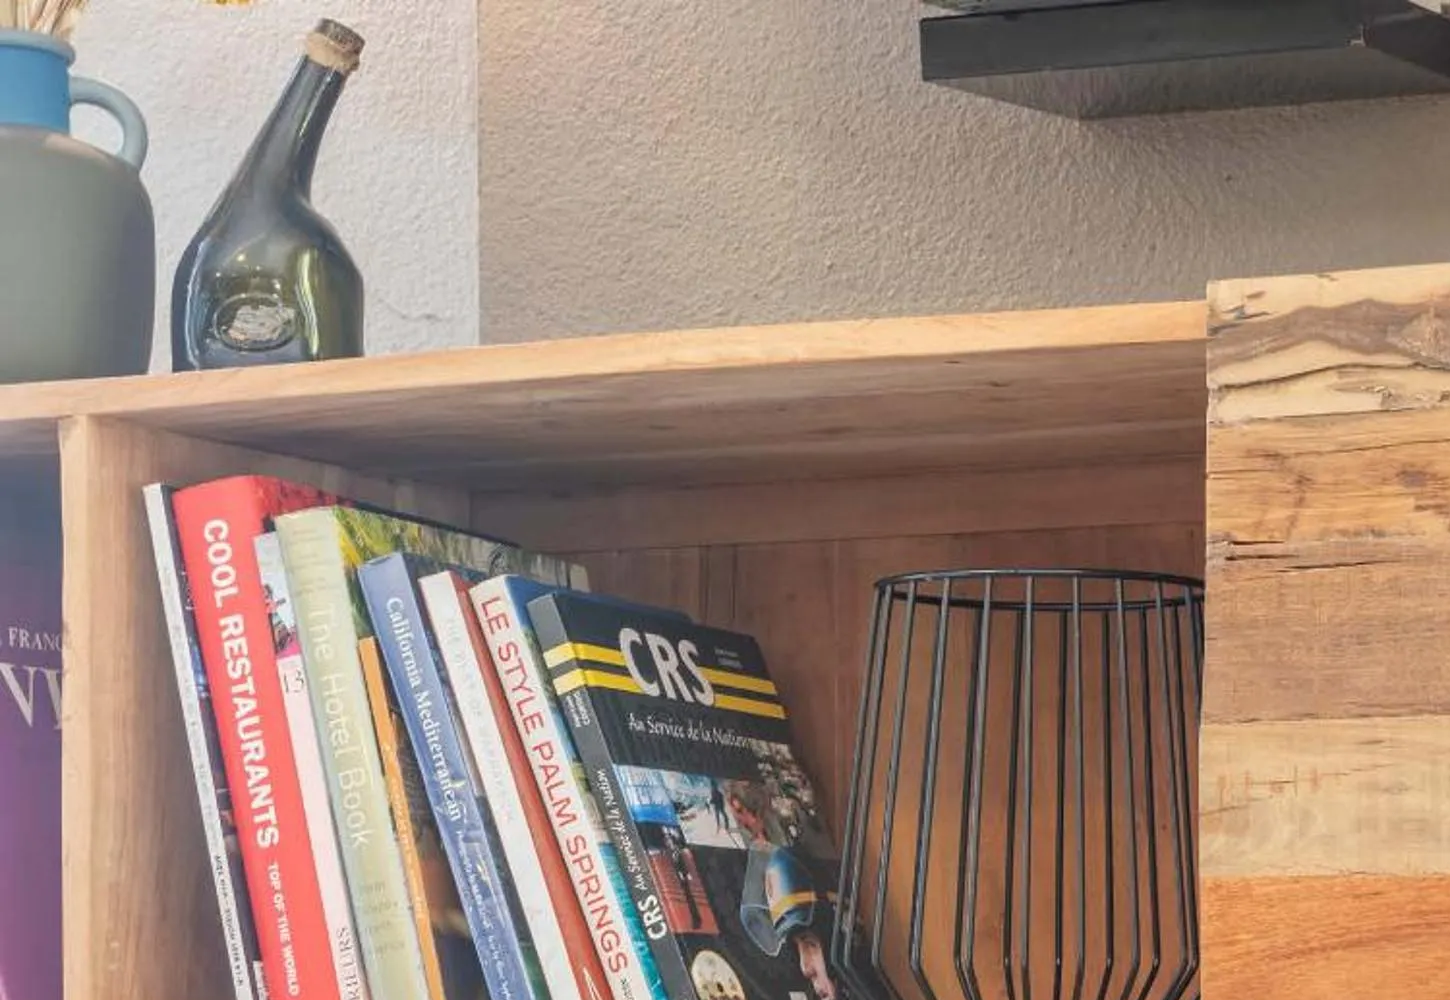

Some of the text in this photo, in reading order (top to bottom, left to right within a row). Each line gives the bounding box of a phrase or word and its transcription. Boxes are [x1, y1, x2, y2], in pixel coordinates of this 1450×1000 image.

[203, 519, 234, 607] COOL
[619, 628, 714, 707] CRS
[217, 613, 280, 849] RESTAURANTS
[309, 602, 375, 849] The Hotel Book
[386, 596, 420, 691] California
[414, 691, 462, 822] Mediterranean
[648, 716, 685, 738] Service
[481, 596, 628, 974] LE STYLE PALM SPRINGS
[595, 768, 614, 807] Nation
[270, 862, 282, 890] TOP
[618, 835, 641, 876] Service
[638, 893, 669, 941] CRS
[281, 940, 301, 997] WORLD
